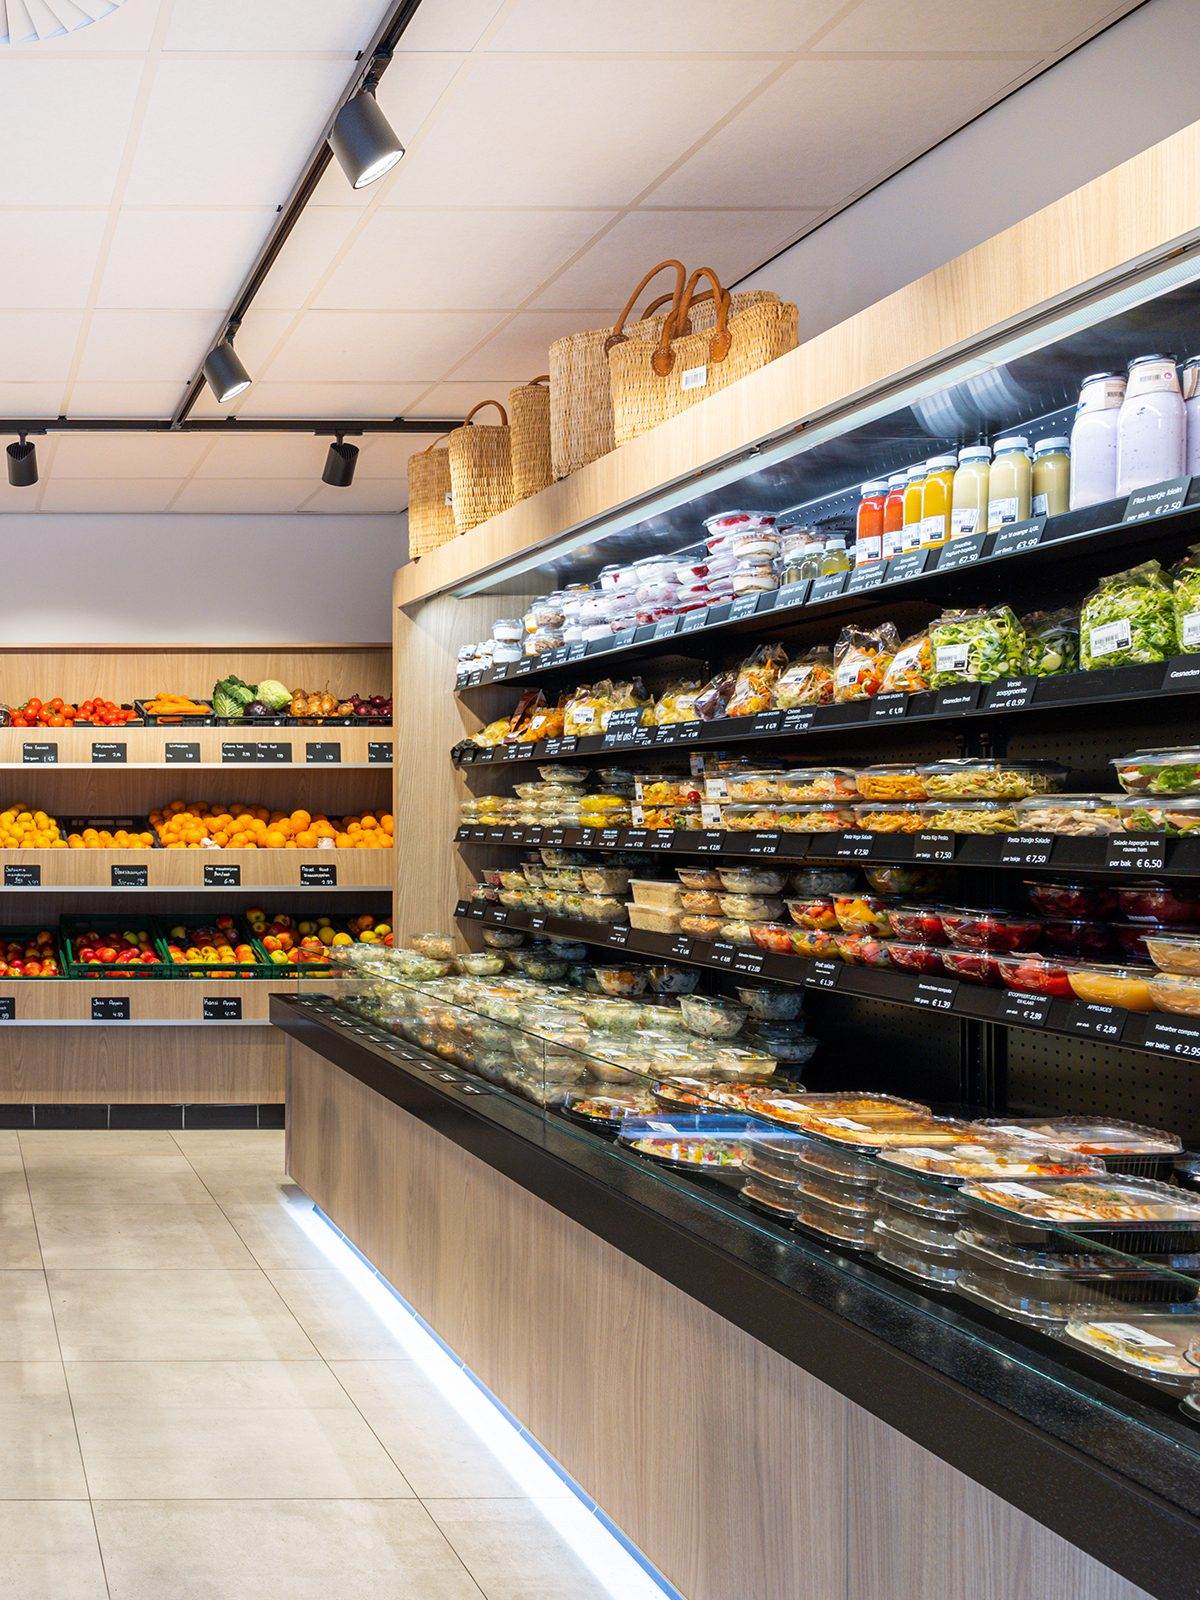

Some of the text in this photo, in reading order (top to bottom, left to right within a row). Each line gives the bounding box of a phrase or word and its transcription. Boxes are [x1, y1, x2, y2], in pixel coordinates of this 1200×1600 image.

[1155, 506, 1162, 515] €
[1163, 501, 1181, 513] 2.50
[958, 553, 978, 565] €2.50
[1006, 700, 1012, 708] €
[1012, 698, 1025, 707] 0.99
[940, 851, 952, 860] 7,50
[1025, 855, 1031, 863] €
[1031, 855, 1047, 864] 7,50
[1137, 859, 1143, 868] €
[1144, 859, 1162, 869] 6,50
[932, 998, 938, 1007] €
[937, 999, 951, 1009] 1.39
[1023, 1010, 1029, 1018] €
[1095, 1023, 1102, 1032] €
[1103, 1024, 1117, 1034] 2,99
[1155, 1024, 1200, 1037] Rabarber compote
[1155, 1043, 1171, 1051] bakje
[1175, 1044, 1182, 1053] €
